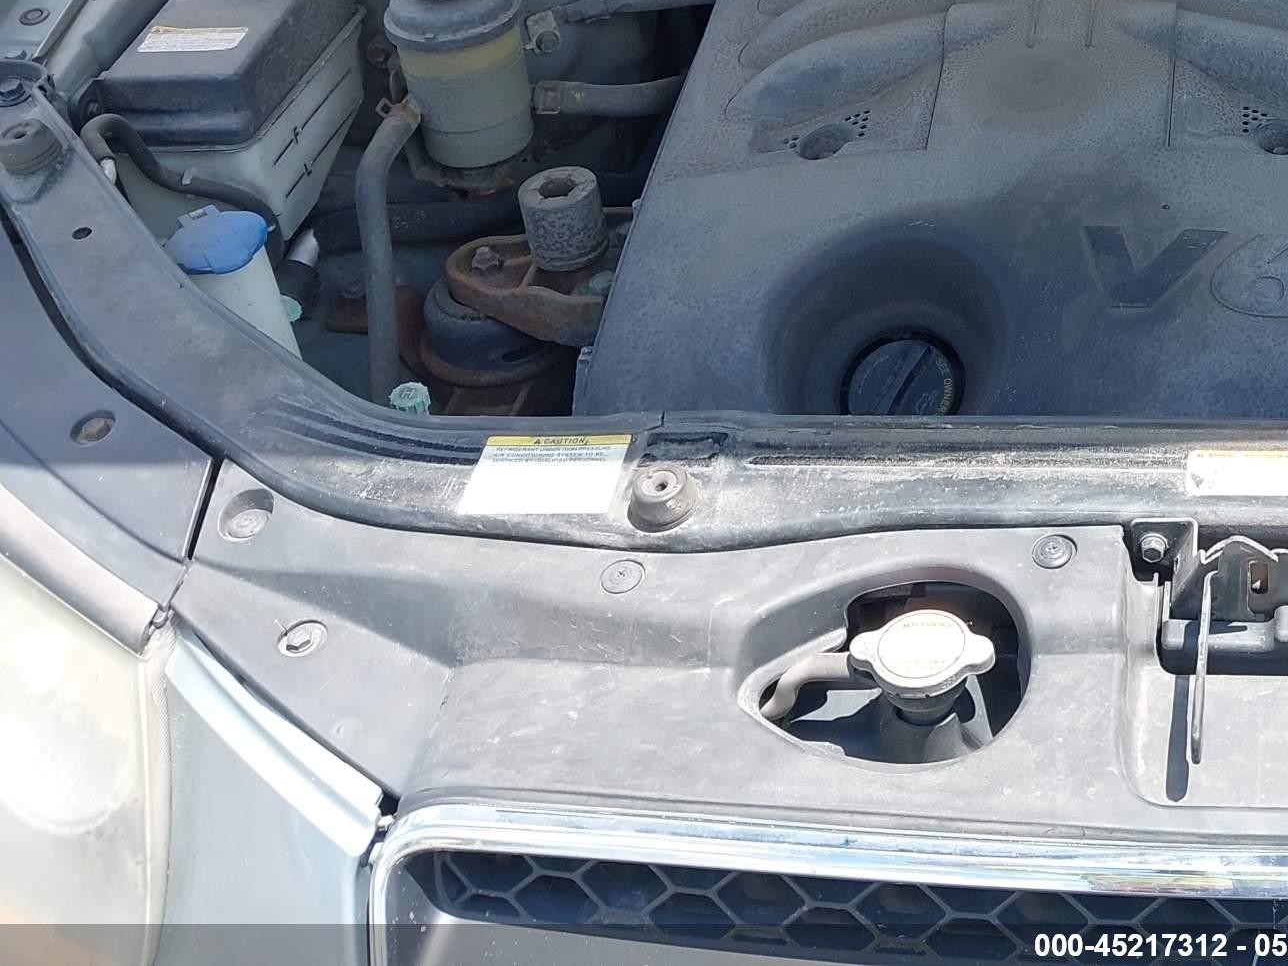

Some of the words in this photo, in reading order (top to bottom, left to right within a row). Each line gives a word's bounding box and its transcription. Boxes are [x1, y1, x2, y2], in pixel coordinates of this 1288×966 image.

[293, 126, 300, 143] F
[303, 163, 313, 177] L
[543, 437, 586, 445] CAUTION
